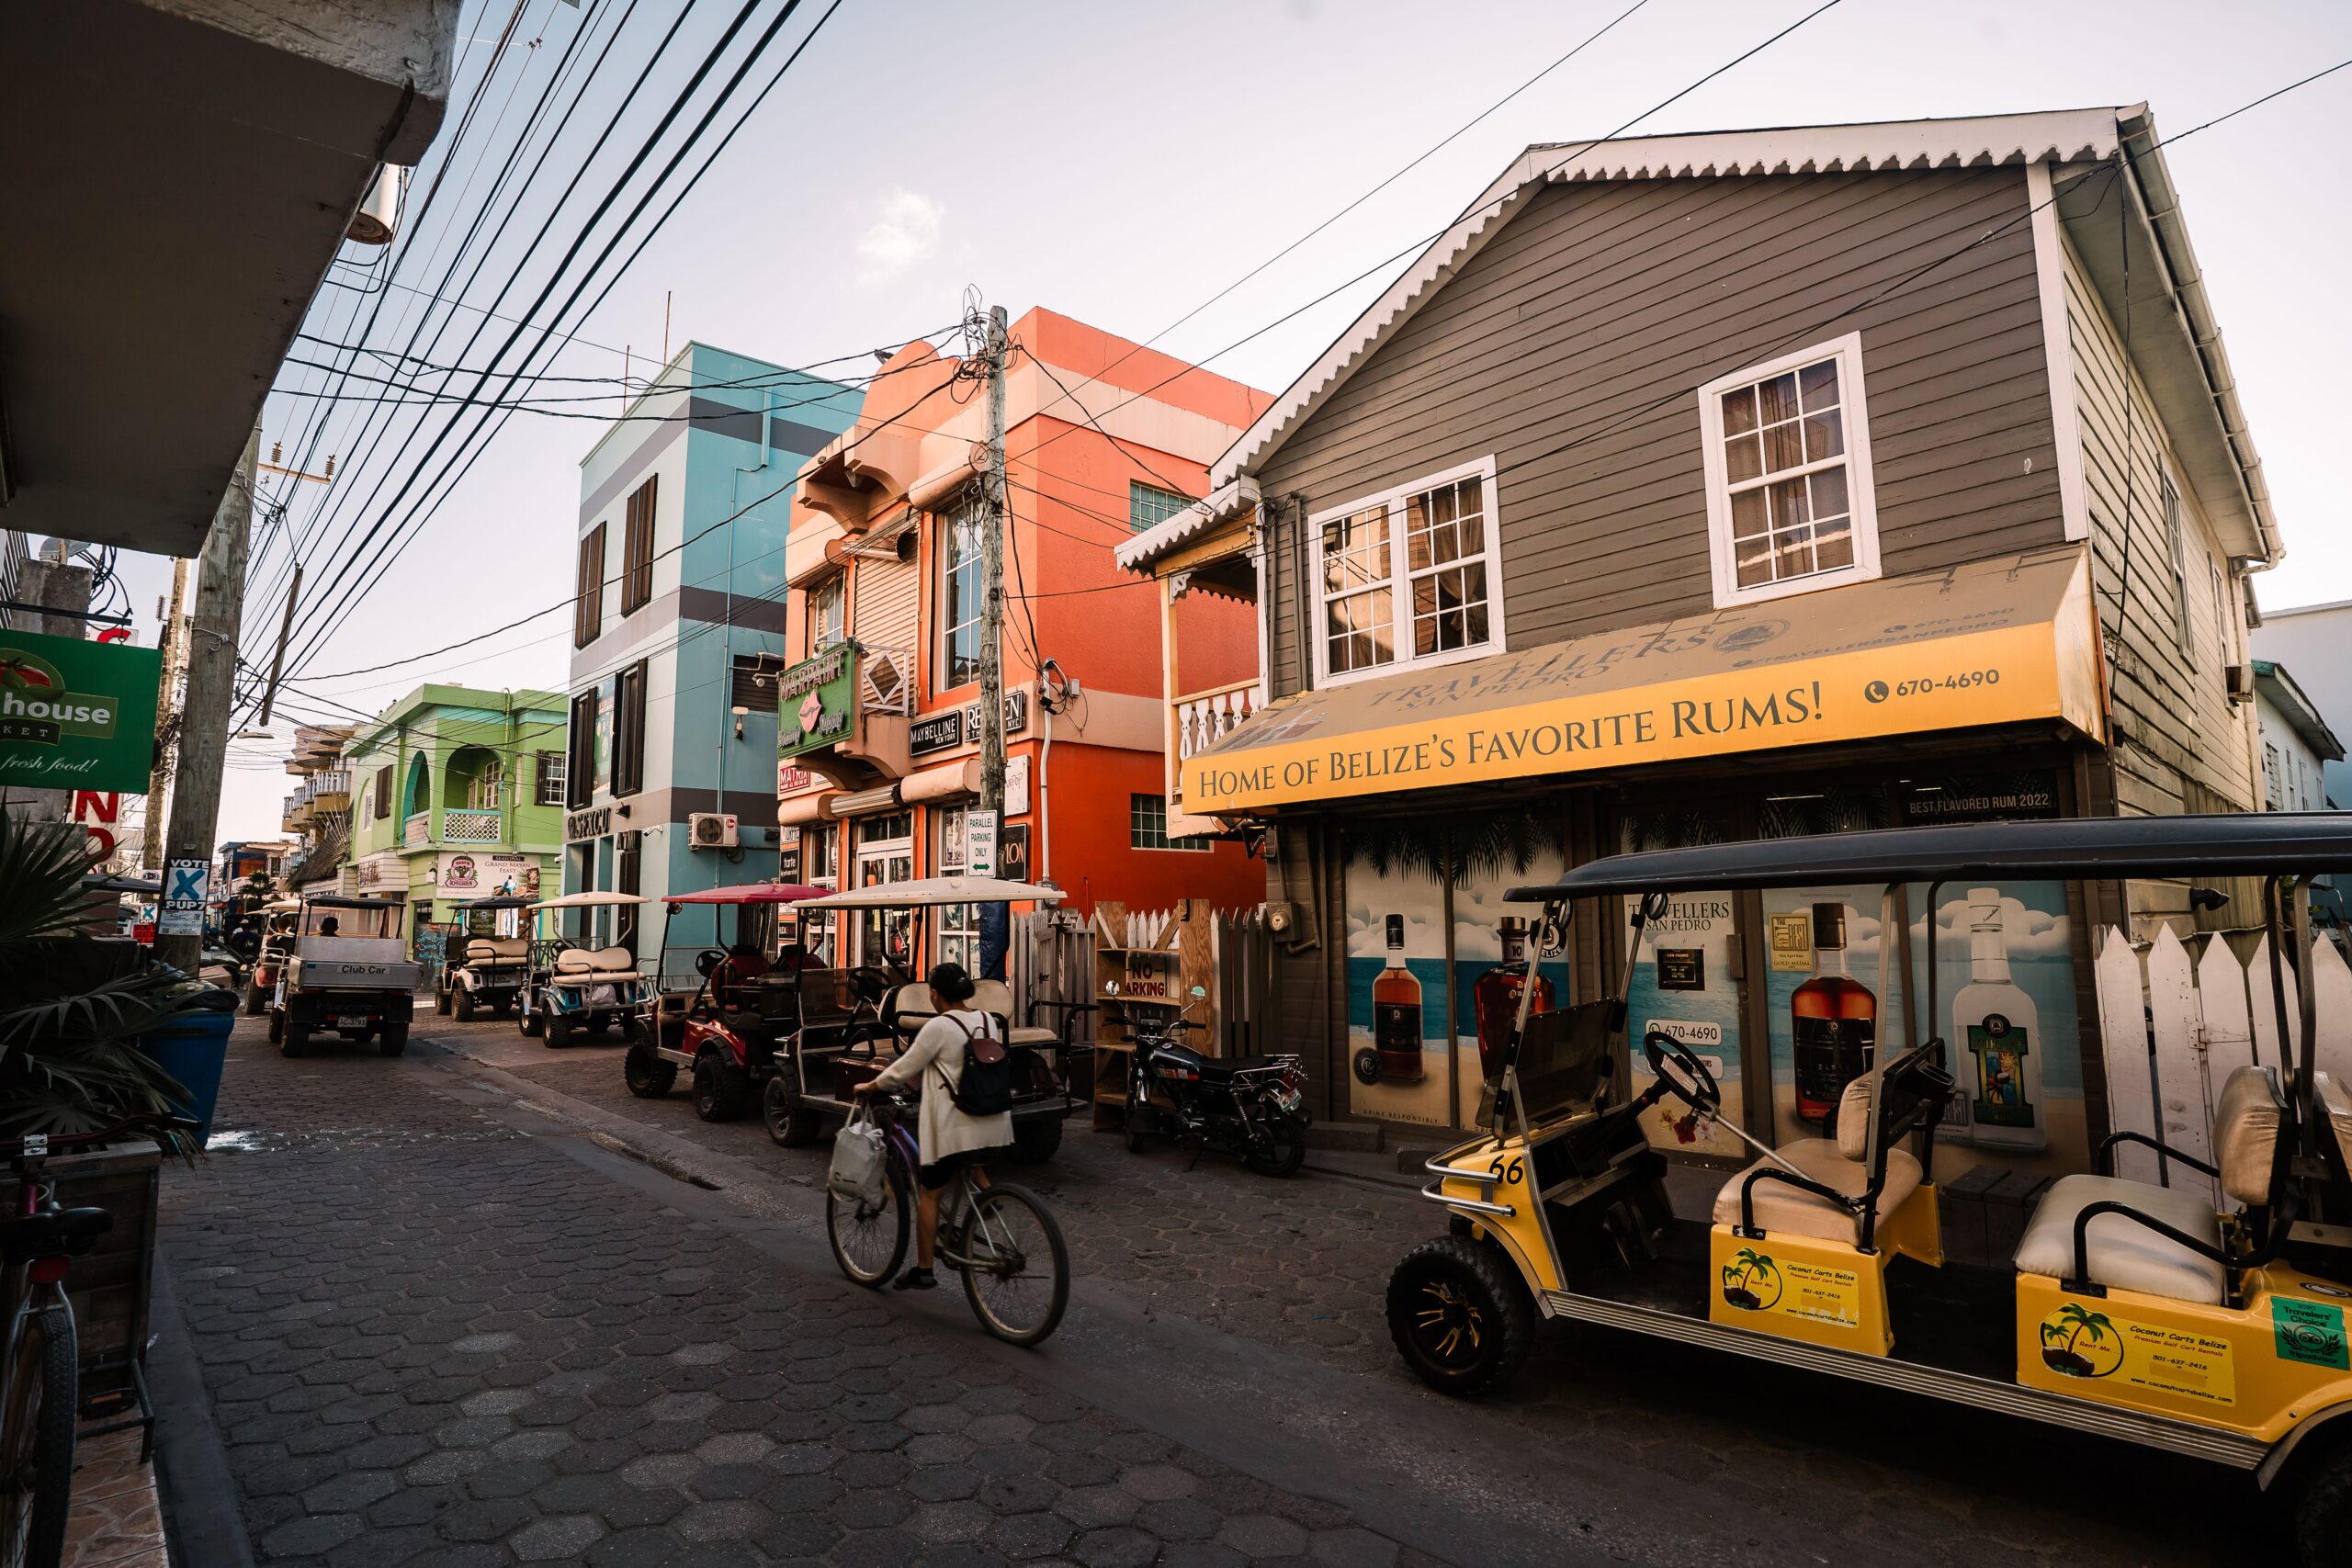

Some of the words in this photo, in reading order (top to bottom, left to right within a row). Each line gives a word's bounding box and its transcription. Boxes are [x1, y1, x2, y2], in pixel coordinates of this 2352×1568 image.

[779, 649, 843, 702] WARPAINT
[1469, 664, 1611, 698] PEDRO
[1895, 669, 2000, 697] 670-4690
[4, 692, 110, 724] house
[967, 695, 1020, 731] REEN
[911, 718, 956, 743] MAYBELLINE
[1008, 718, 1020, 728] NYC
[3, 726, 48, 737] KET
[935, 736, 944, 744] NEW
[944, 733, 956, 742] YORK
[1199, 765, 1276, 797] HOME
[1283, 758, 1319, 787] OF
[1329, 733, 1455, 783] BELIZE'S
[1468, 709, 1657, 765] FAVORITE
[1671, 681, 1824, 739] RUMS!
[38, 756, 98, 773] food!
[1909, 800, 1934, 814] BEST
[1937, 796, 1989, 813] FLAVORED
[1992, 795, 2017, 808] RUM
[2019, 793, 2050, 807] 2022
[969, 818, 993, 828] PARALLEL
[616, 830, 637, 851] ATM
[970, 832, 991, 842] PARKING
[975, 847, 987, 857] ONLY
[171, 859, 209, 869] VOTE
[784, 856, 797, 868] tarte
[1629, 901, 1730, 919] TVELLERS
[1646, 919, 1668, 931] SAN
[1671, 919, 1711, 931] PEDRO
[1511, 945, 1521, 956] 10
[1541, 945, 1563, 957] ELIZE
[342, 965, 366, 974] Club
[368, 965, 387, 974] Car
[1125, 982, 1165, 997] ARKING
[1665, 1024, 1718, 1040] 670-4690
[1388, 1112, 1439, 1124] RESPONSIBLY
[1786, 1264, 1812, 1274] Coconut
[1814, 1269, 1832, 1278] Carts
[1835, 1273, 1855, 1281] Belize
[2283, 1306, 2332, 1321] Travelers'
[2290, 1315, 2327, 1327] Choice
[2079, 1340, 2097, 1349] Rent
[2130, 1325, 2165, 1338] Coconut
[2168, 1333, 2195, 1344] Carts
[2199, 1338, 2227, 1350] Belize
[2133, 1335, 2161, 1345] Premium
[2164, 1340, 2177, 1348] Golf
[2180, 1343, 2195, 1351] Cart
[2198, 1347, 2223, 1357] Rentals
[2153, 1354, 2208, 1371] 501-637-2416
[2288, 1349, 2337, 1364] Tripadvisor
[2131, 1377, 2233, 1404] www.coconutcartsbelize.com
